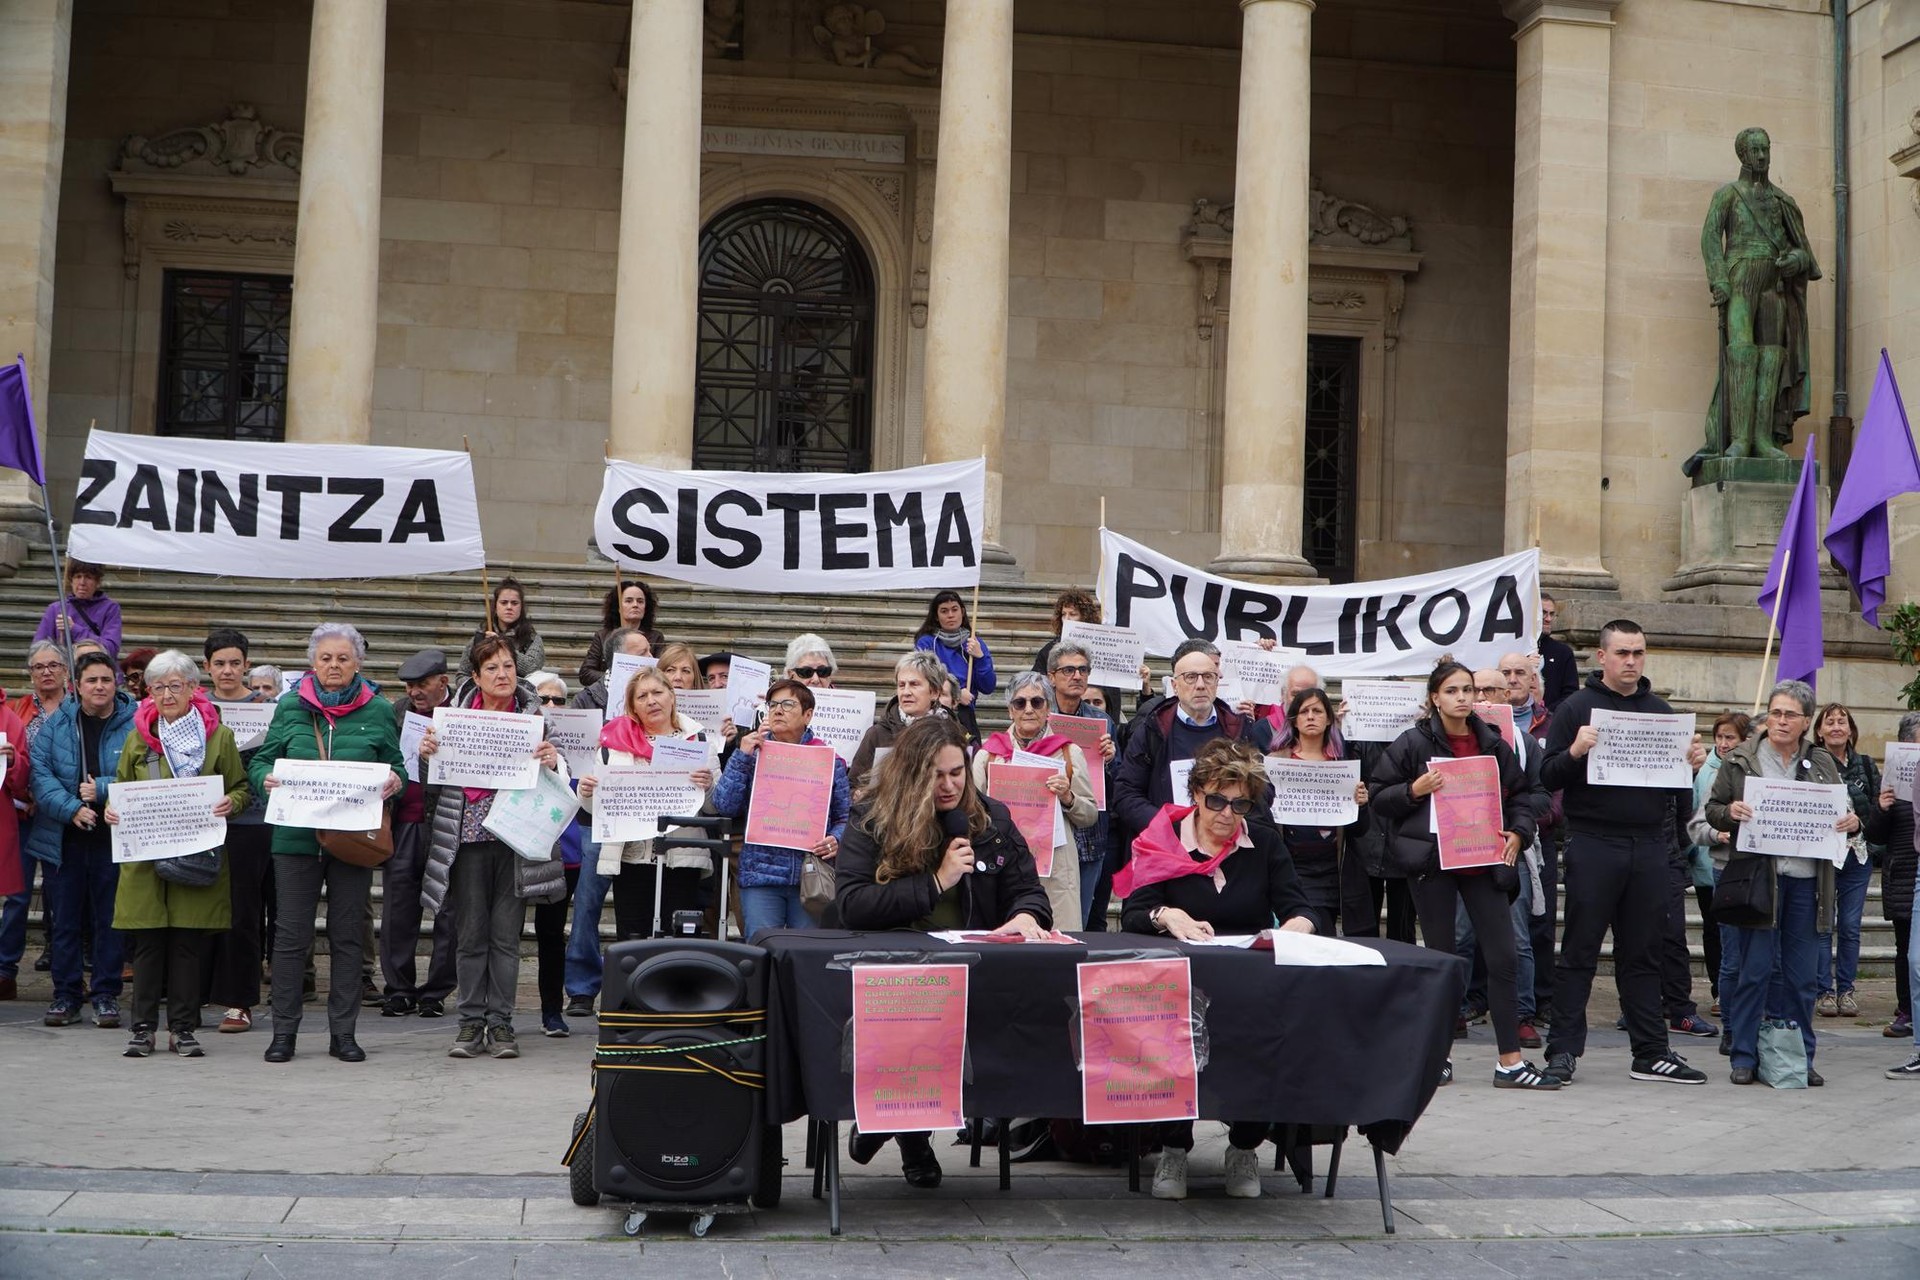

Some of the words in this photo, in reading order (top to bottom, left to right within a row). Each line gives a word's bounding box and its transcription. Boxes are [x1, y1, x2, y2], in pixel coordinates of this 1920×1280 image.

[811, 137, 900, 152] GENERALES
[71, 458, 445, 543] ZAINTZA
[611, 487, 977, 571] SISTEMA
[1115, 552, 1524, 656] PUBLIKOA
[1243, 666, 1281, 674] GUTXIENEKO
[817, 706, 861, 714] PERTSONAN
[482, 727, 529, 735] EZGAITASUNA
[474, 732, 526, 741] DEPENDENTZIA
[467, 737, 531, 748] PERTSONENTZAKO
[459, 750, 512, 758] PUBLIFIKATZEA
[451, 768, 491, 776] PUBLIKOAK
[1270, 770, 1312, 778] DIVERSIDAD
[282, 780, 329, 788] EQUIPARAR
[331, 782, 377, 792] PENSIONES
[1762, 799, 1834, 809] ATZERRITARTASUN
[157, 812, 206, 820] TRABAJADORAS
[1757, 820, 1833, 829] ERREGULARIZAZIOA
[119, 826, 179, 835] INFRAESTRUCTURAS
[1762, 833, 1824, 842] MIGRATUENTZAT
[865, 976, 950, 987] ZAINTZAK
[1092, 983, 1178, 995] CUIDADOS
[662, 1154, 689, 1163] ibiza
